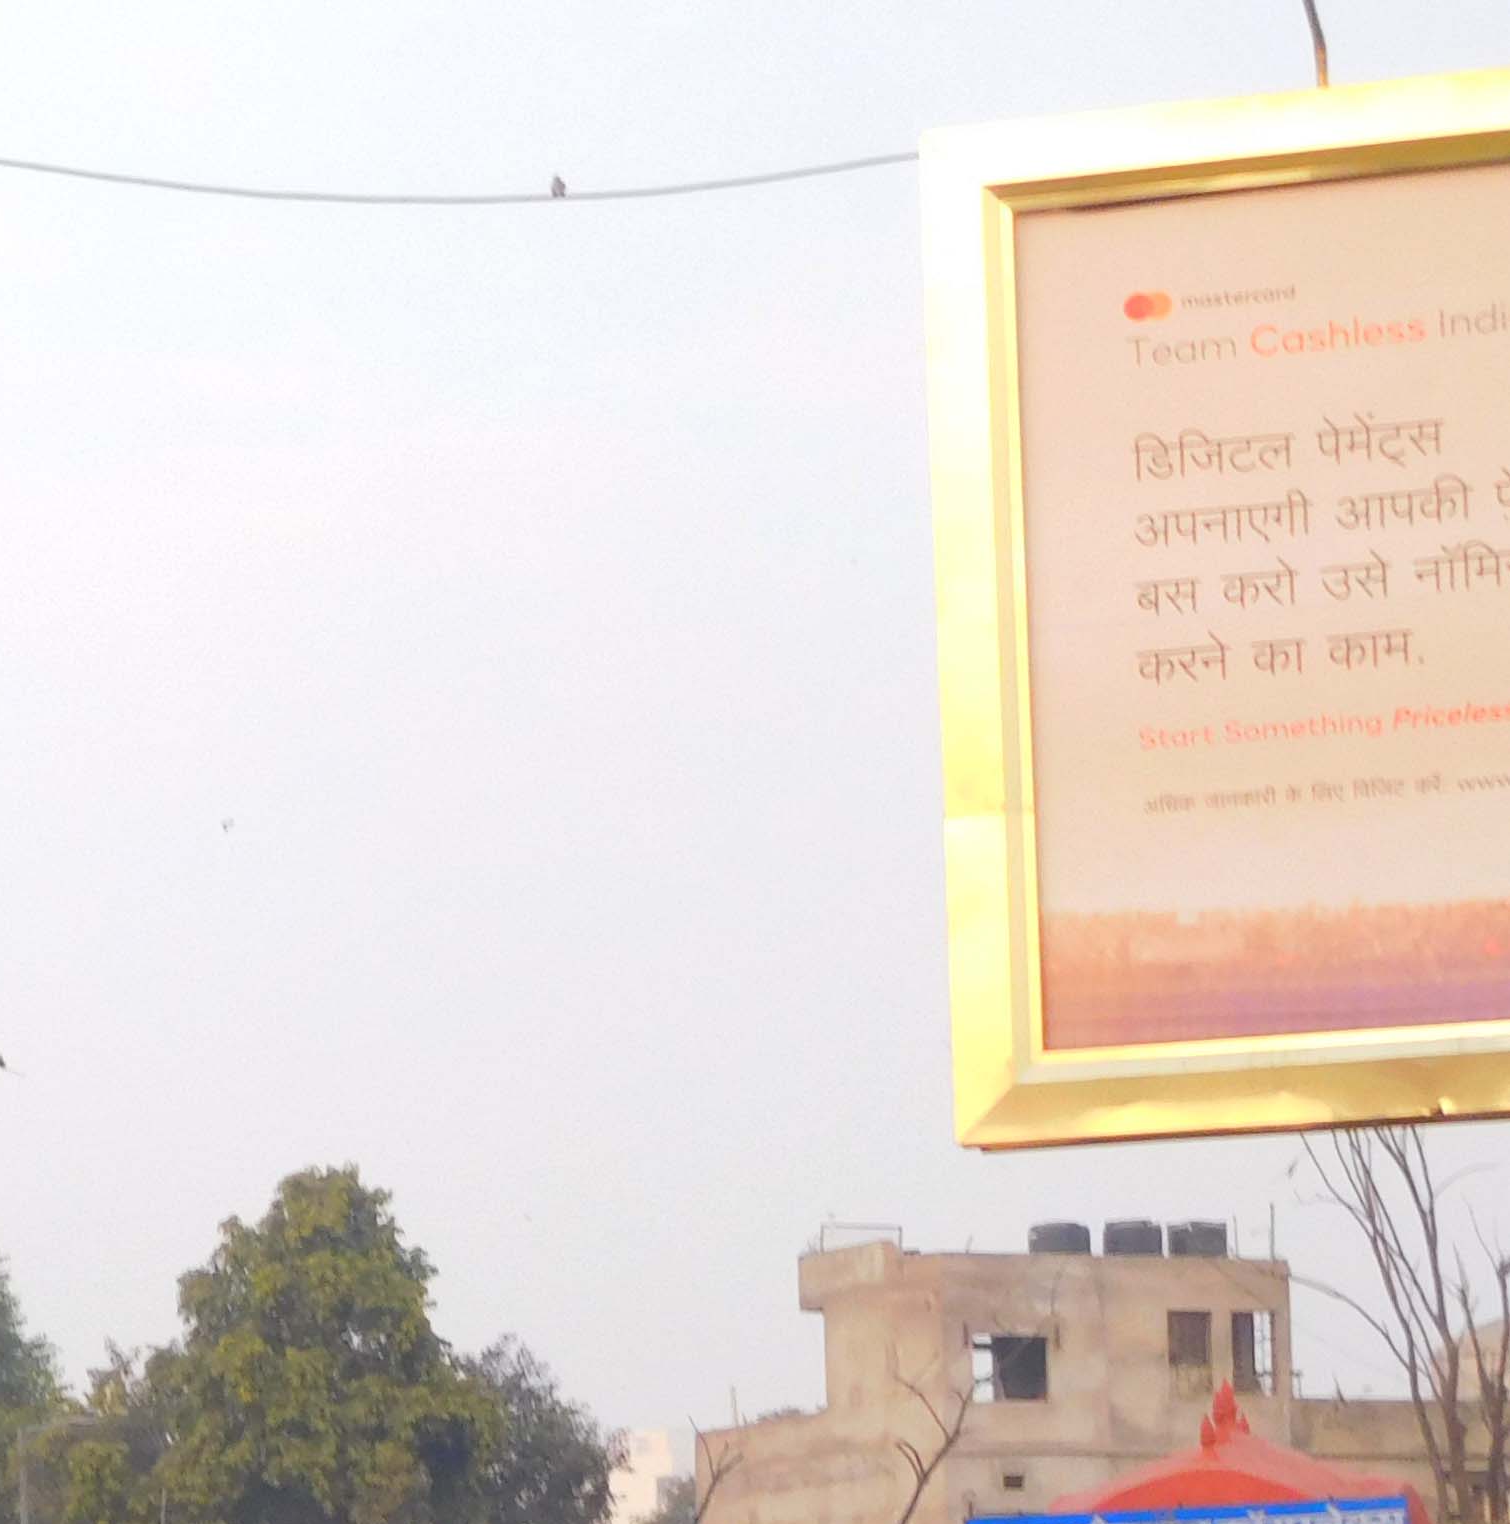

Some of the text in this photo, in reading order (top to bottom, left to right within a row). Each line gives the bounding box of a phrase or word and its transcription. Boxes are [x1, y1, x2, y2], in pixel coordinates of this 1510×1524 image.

[1126, 334, 1237, 368] Team
[1249, 316, 1428, 358] Cashless
[1133, 412, 1445, 482] डिजिटल पेमेंट्स
[1133, 488, 1313, 548] अपनाएगी
[1335, 472, 1474, 530] आपकी
[1136, 575, 1202, 617] बस
[1220, 556, 1299, 609] करो
[1321, 550, 1393, 600] उसे
[1136, 627, 1426, 688] करने का काम.
[1139, 721, 1215, 751] Start
[1224, 712, 1383, 744] Something
